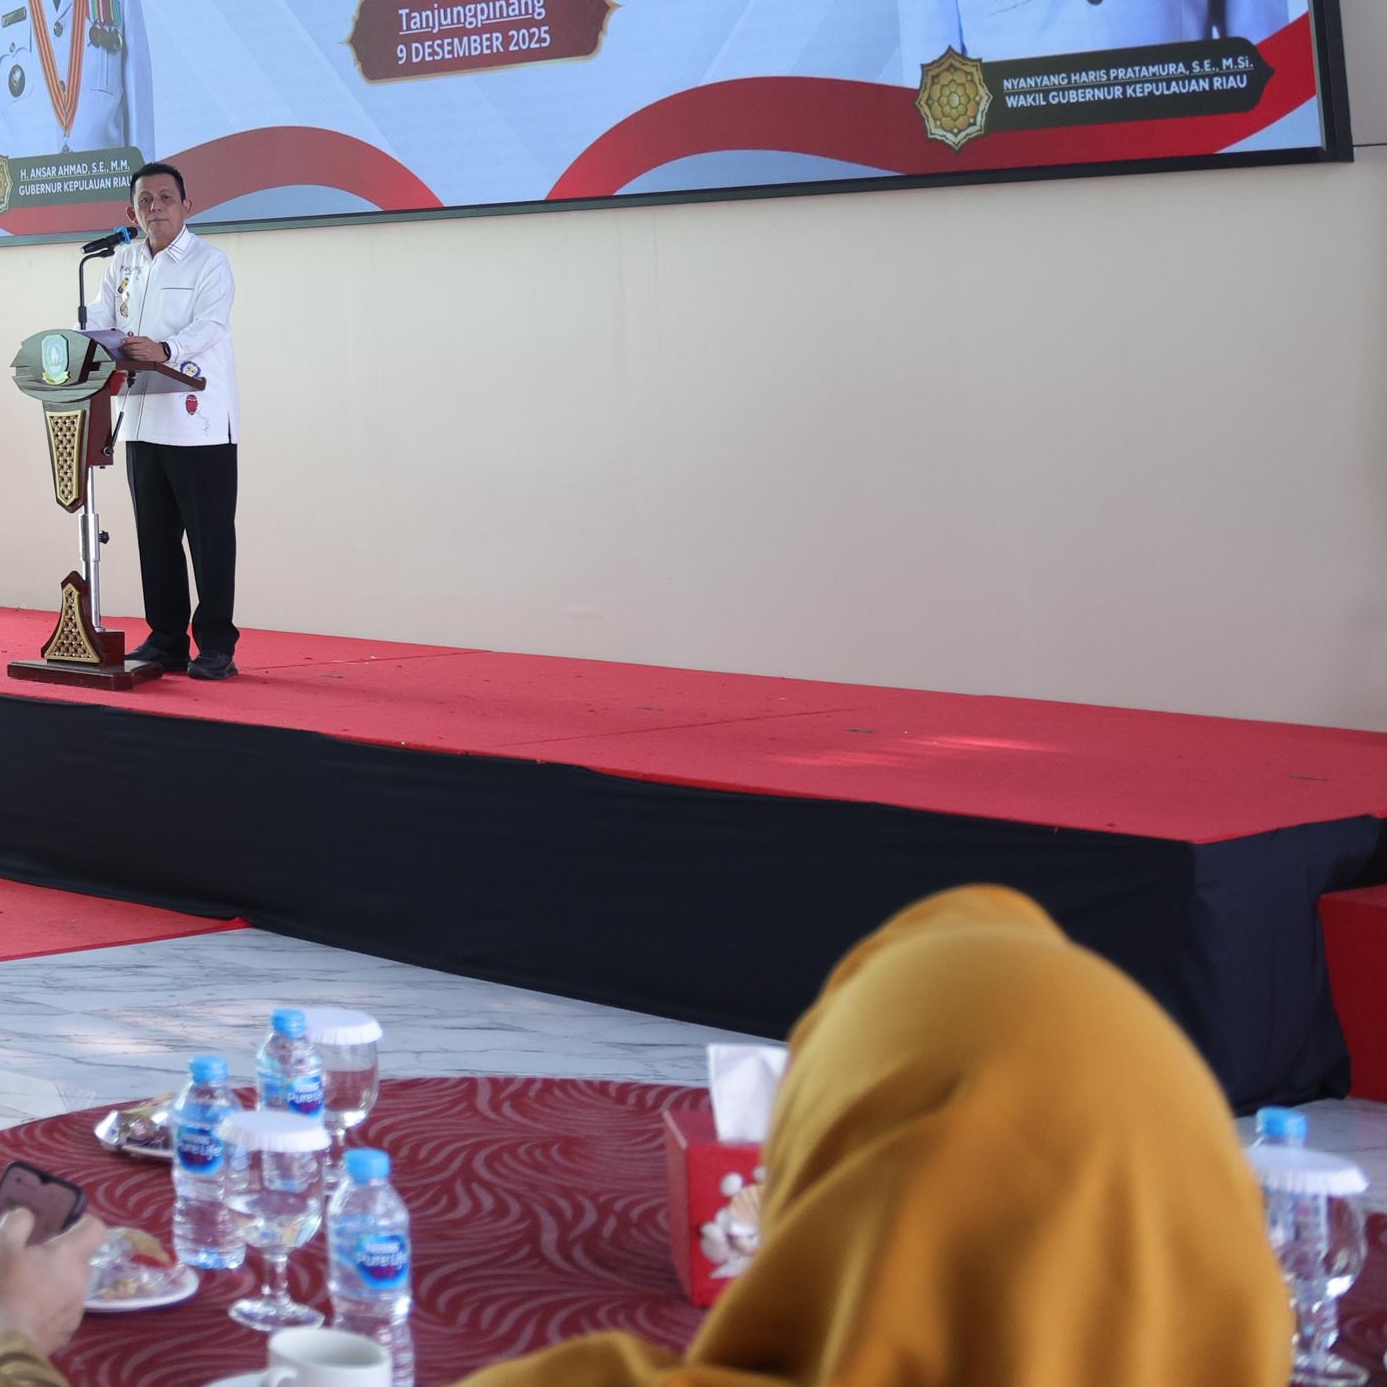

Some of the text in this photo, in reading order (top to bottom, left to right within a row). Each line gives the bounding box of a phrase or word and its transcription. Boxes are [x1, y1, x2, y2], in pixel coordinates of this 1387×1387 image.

[397, 26, 551, 65] 9 DESEMBER 2025
[1003, 74, 1069, 90] NYANYANG
[1071, 71, 1108, 84] HARIS
[1110, 62, 1189, 81] PRATAMURA,
[1222, 56, 1254, 70] M.Si.
[1005, 74, 1248, 109] WAKIL GUBERNUR KEPULAUAN RIAU
[18, 182, 62, 196] GUBERNUR
[63, 177, 112, 192] KEPULAUAN
[20, 169, 29, 180] H.
[30, 166, 57, 179] ANSAR
[58, 163, 91, 176] AHMAD,
[110, 159, 130, 171] M.M.
